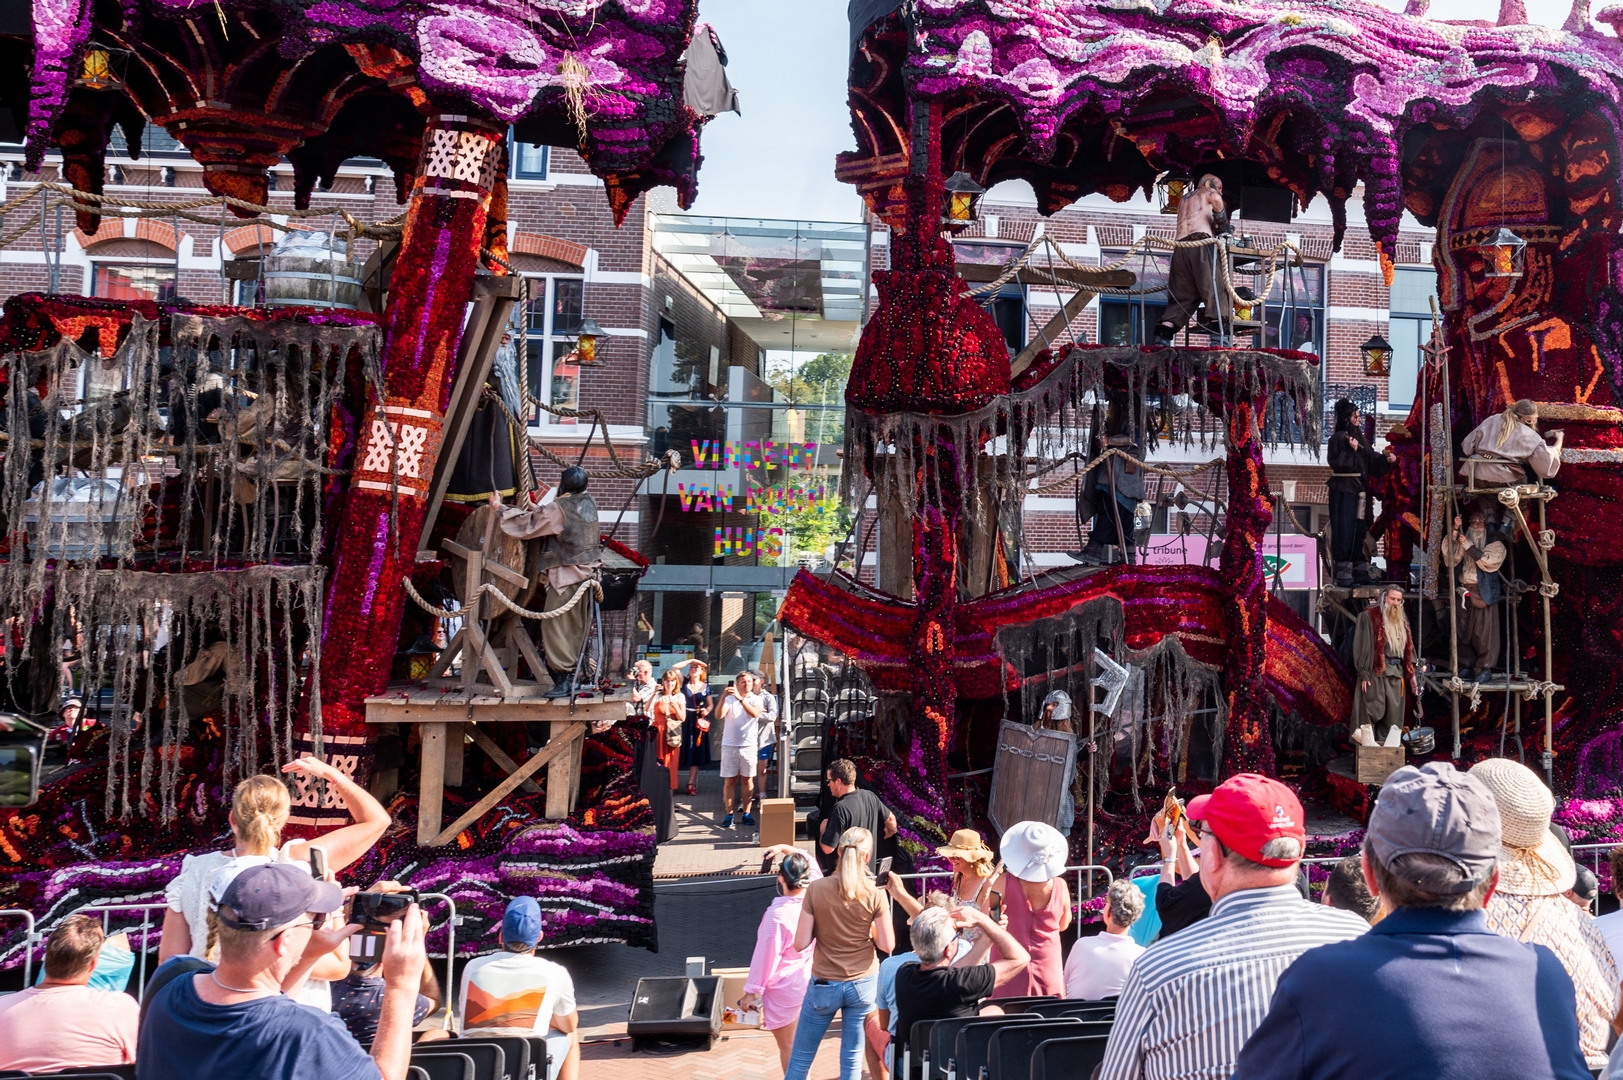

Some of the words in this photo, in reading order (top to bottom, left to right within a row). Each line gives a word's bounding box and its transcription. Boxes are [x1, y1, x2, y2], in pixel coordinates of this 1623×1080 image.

[690, 439, 817, 470] VINCENT
[678, 483, 733, 512] VAN
[746, 484, 825, 514] GOGH
[715, 526, 783, 557] HUIS
[1153, 546, 1188, 555] tribune
